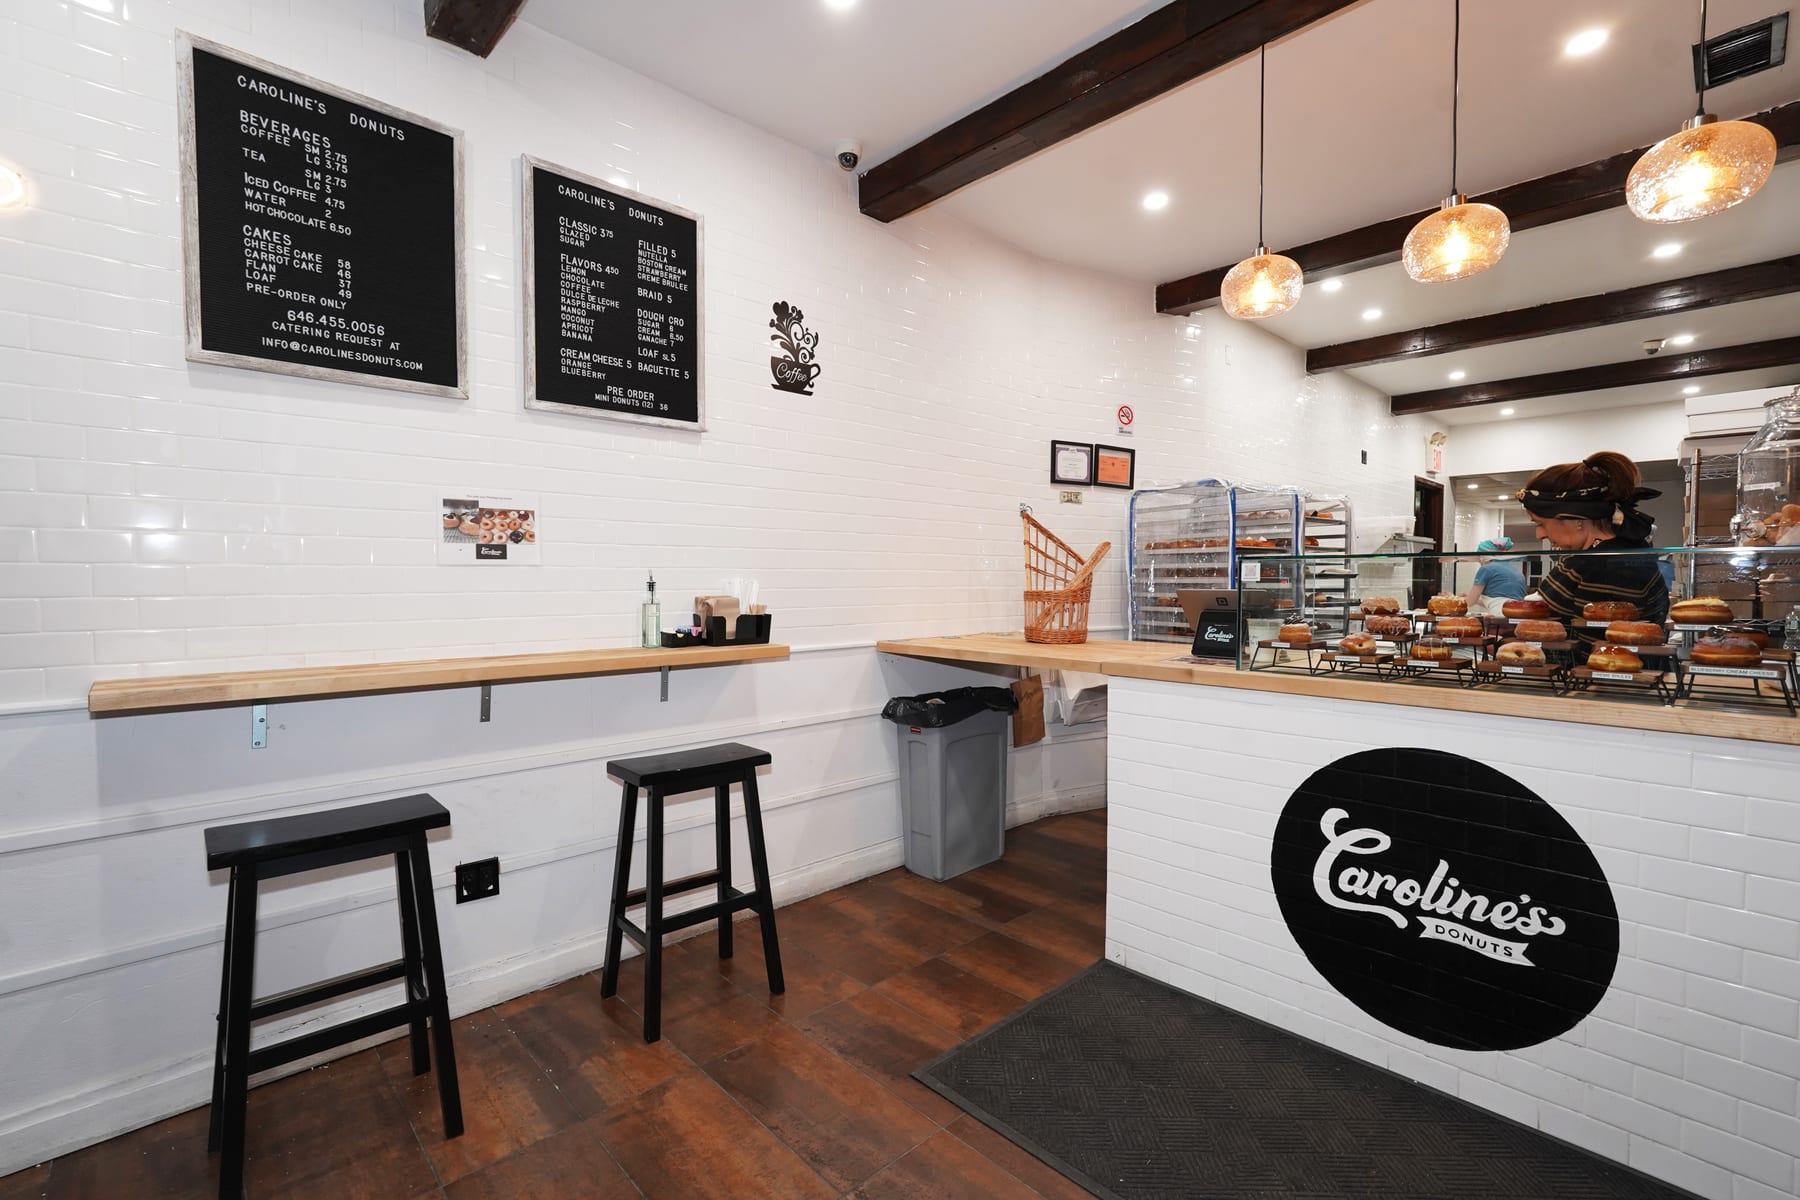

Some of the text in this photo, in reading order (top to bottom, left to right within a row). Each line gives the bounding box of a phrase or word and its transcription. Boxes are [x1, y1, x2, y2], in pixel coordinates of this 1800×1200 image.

[237, 75, 405, 141] CAROLINE'S DONUTS
[240, 110, 331, 148] BEVERAGES
[240, 124, 347, 164] COFFEE SM 2.75
[242, 147, 347, 188] TEA SM 2.75
[306, 154, 348, 174] LG 3.75
[306, 180, 332, 194] LG 3
[244, 187, 332, 219] WATER 2
[324, 197, 345, 210] 4.75
[558, 184, 663, 226] CAROLINE'S DONUTS
[245, 201, 265, 214] HOT
[267, 207, 326, 229] CHOCOLATE
[242, 224, 292, 246] CAKES
[559, 216, 597, 235] CLASSIC
[560, 227, 590, 241] GLAZED
[560, 235, 585, 248] SUGAR
[638, 240, 677, 258] FILLED 5
[244, 238, 351, 270] CHEESE CAKE 58
[245, 249, 290, 266] CARROT
[293, 260, 323, 274] CAKE
[638, 249, 668, 263] NUTELLA
[561, 253, 619, 275] FLAVORS 450
[561, 264, 586, 277] LEMON
[637, 265, 681, 282] STRAWBERRY
[638, 257, 687, 276] BOSTON CREAM
[245, 269, 276, 283] LOAF
[246, 259, 351, 289] FLAN 37
[560, 273, 605, 289] CHOCOLATE
[637, 273, 688, 292] CREME BRULEE
[246, 282, 347, 310] PRE-ORDER ONLY
[560, 281, 591, 294] COFFEE
[637, 287, 673, 303] BRAID 5
[560, 297, 606, 313] RASPBERRY
[561, 288, 620, 309] DULCE DE LECHE
[560, 305, 586, 317] MANGO
[561, 313, 595, 326] COCONUT
[637, 308, 684, 327] DOUGH CRO
[287, 310, 385, 336] 646.455.0056
[561, 321, 594, 334] APRICOT
[637, 326, 660, 336] CREAM
[638, 318, 660, 329] SUGAR
[272, 321, 400, 351] CATERING REQUEST AT
[561, 329, 592, 342] BANANA
[262, 337, 423, 371] INFO@CAROLINESDONUTS.COM
[560, 348, 632, 369] CREAM CHEESE 5
[638, 347, 659, 359] LOAF
[560, 358, 592, 369] ORANGE
[561, 366, 606, 380] BLUEBERRY
[638, 362, 690, 379] BAGUETTE 5
[776, 362, 807, 384] Coffee
[595, 393, 610, 402] MINI
[612, 396, 640, 407] DONUTS
[607, 386, 655, 401] PRE ORDER
[1312, 807, 1566, 937] Caroline's
[1435, 923, 1514, 958] DONUTS
